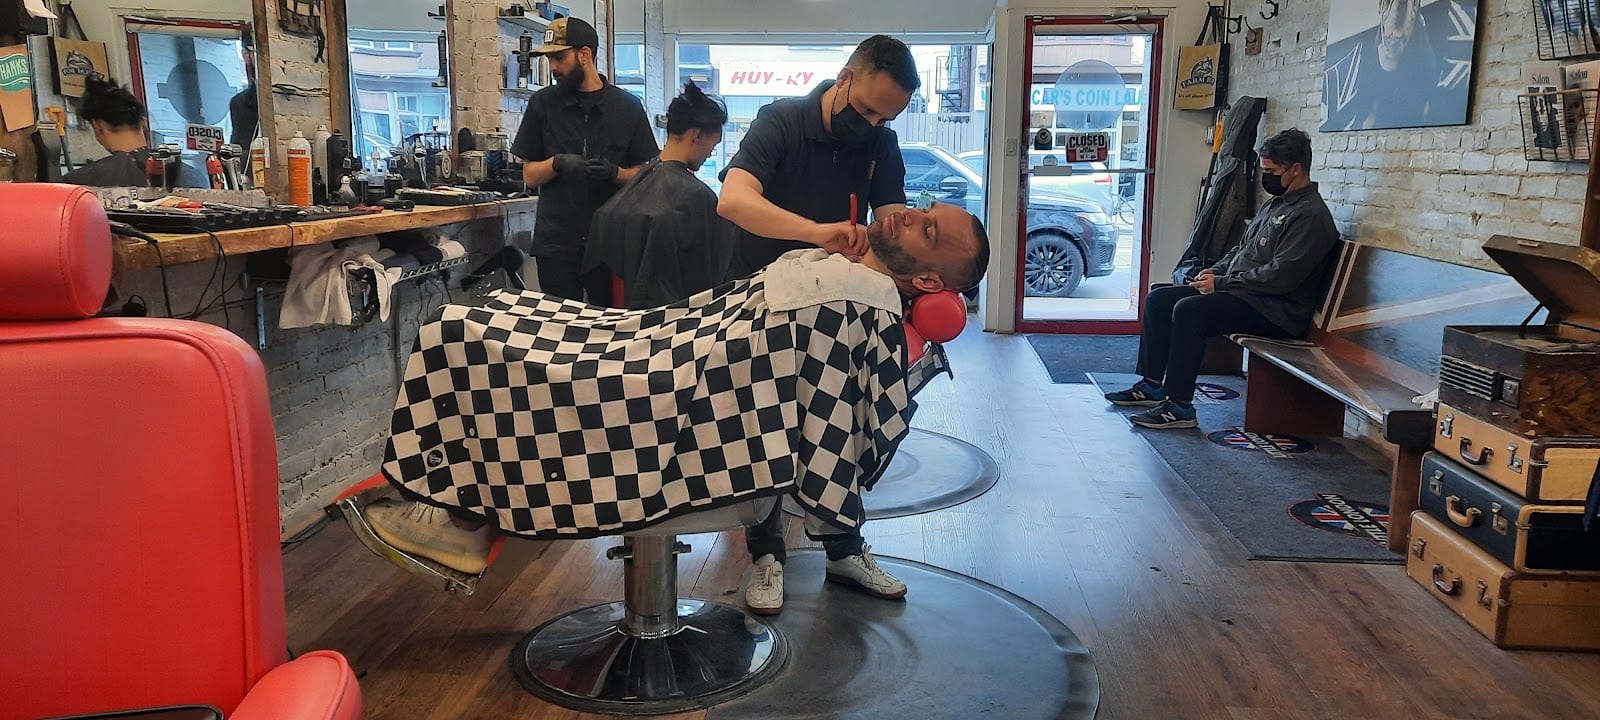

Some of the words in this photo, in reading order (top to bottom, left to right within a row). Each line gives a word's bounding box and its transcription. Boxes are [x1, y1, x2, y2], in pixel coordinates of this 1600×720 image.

[0, 58, 29, 81] HANKS
[731, 71, 814, 86] HUY-KY
[1076, 89, 1110, 106] COIN
[1069, 134, 1105, 148] CLOSED
[1321, 493, 1371, 524] LONDON
